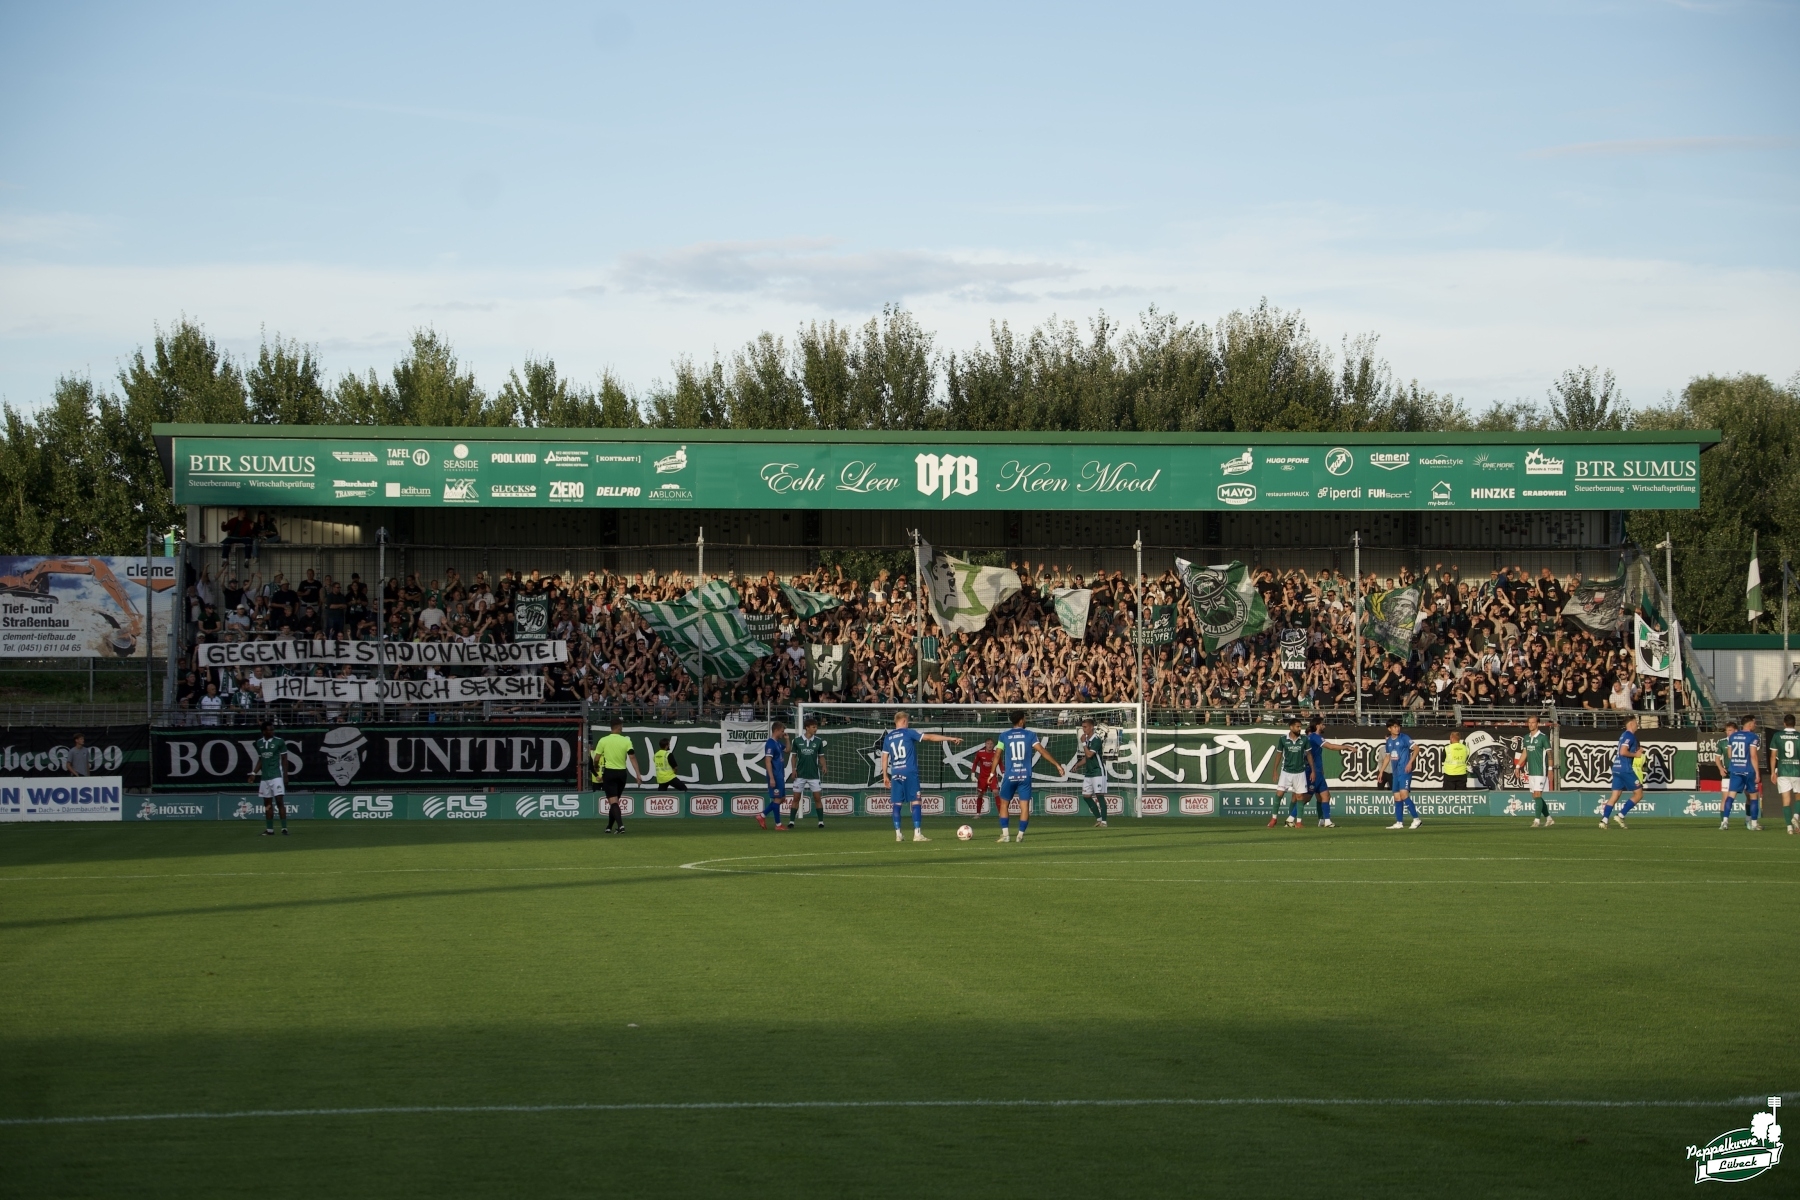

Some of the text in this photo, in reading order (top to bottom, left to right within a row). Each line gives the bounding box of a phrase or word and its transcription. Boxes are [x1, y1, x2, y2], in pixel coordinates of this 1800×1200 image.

[387, 449, 410, 458] TAFEL
[492, 454, 514, 463] POOL
[1370, 452, 1410, 461] clement
[189, 455, 315, 473] BTR SUMUS
[444, 460, 479, 468] SEASIDE
[1419, 458, 1464, 466] Küchenstyle
[1575, 461, 1616, 477] BTR
[1623, 461, 1696, 477] SUMUS
[760, 463, 827, 494] Echt
[835, 460, 900, 493] Leev
[996, 460, 1070, 493] Keen
[1076, 460, 1161, 493] Mood
[189, 480, 315, 489] Steuerberatung Wirtschaftsprüfung
[1575, 485, 1624, 493] Steuerberatung
[401, 486, 431, 494] aditum
[596, 487, 641, 497] DELLPRO
[1222, 488, 1253, 497] MAYO
[1330, 487, 1361, 500] iperdi
[1471, 488, 1515, 498] HINZKE
[2, 603, 52, 614] Tief- und
[2, 617, 69, 627] Straßenbau
[3, 633, 76, 642] clement-tiefbau.de
[18, 644, 42, 652] (0451)
[207, 642, 286, 663] GEGEN
[294, 640, 350, 659] ALLE
[1281, 661, 1306, 670] VBHL
[275, 678, 368, 701] HALTET
[375, 679, 449, 700] DURCH
[890, 739, 906, 760] 16
[1010, 741, 1026, 760] 10
[1732, 742, 1745, 758] 28
[1785, 740, 1794, 758] 9
[384, 737, 571, 773] UNITED
[27, 787, 119, 805] WOISIN
[1345, 796, 1368, 804] IHRE
[352, 796, 393, 811] FLS
[446, 795, 487, 811] FLS
[539, 795, 580, 810] FLS
[159, 806, 203, 814] HOLSTEN
[1346, 806, 1356, 814] IN
[1360, 806, 1380, 814] DER
[1437, 806, 1474, 814] BUCHT.
